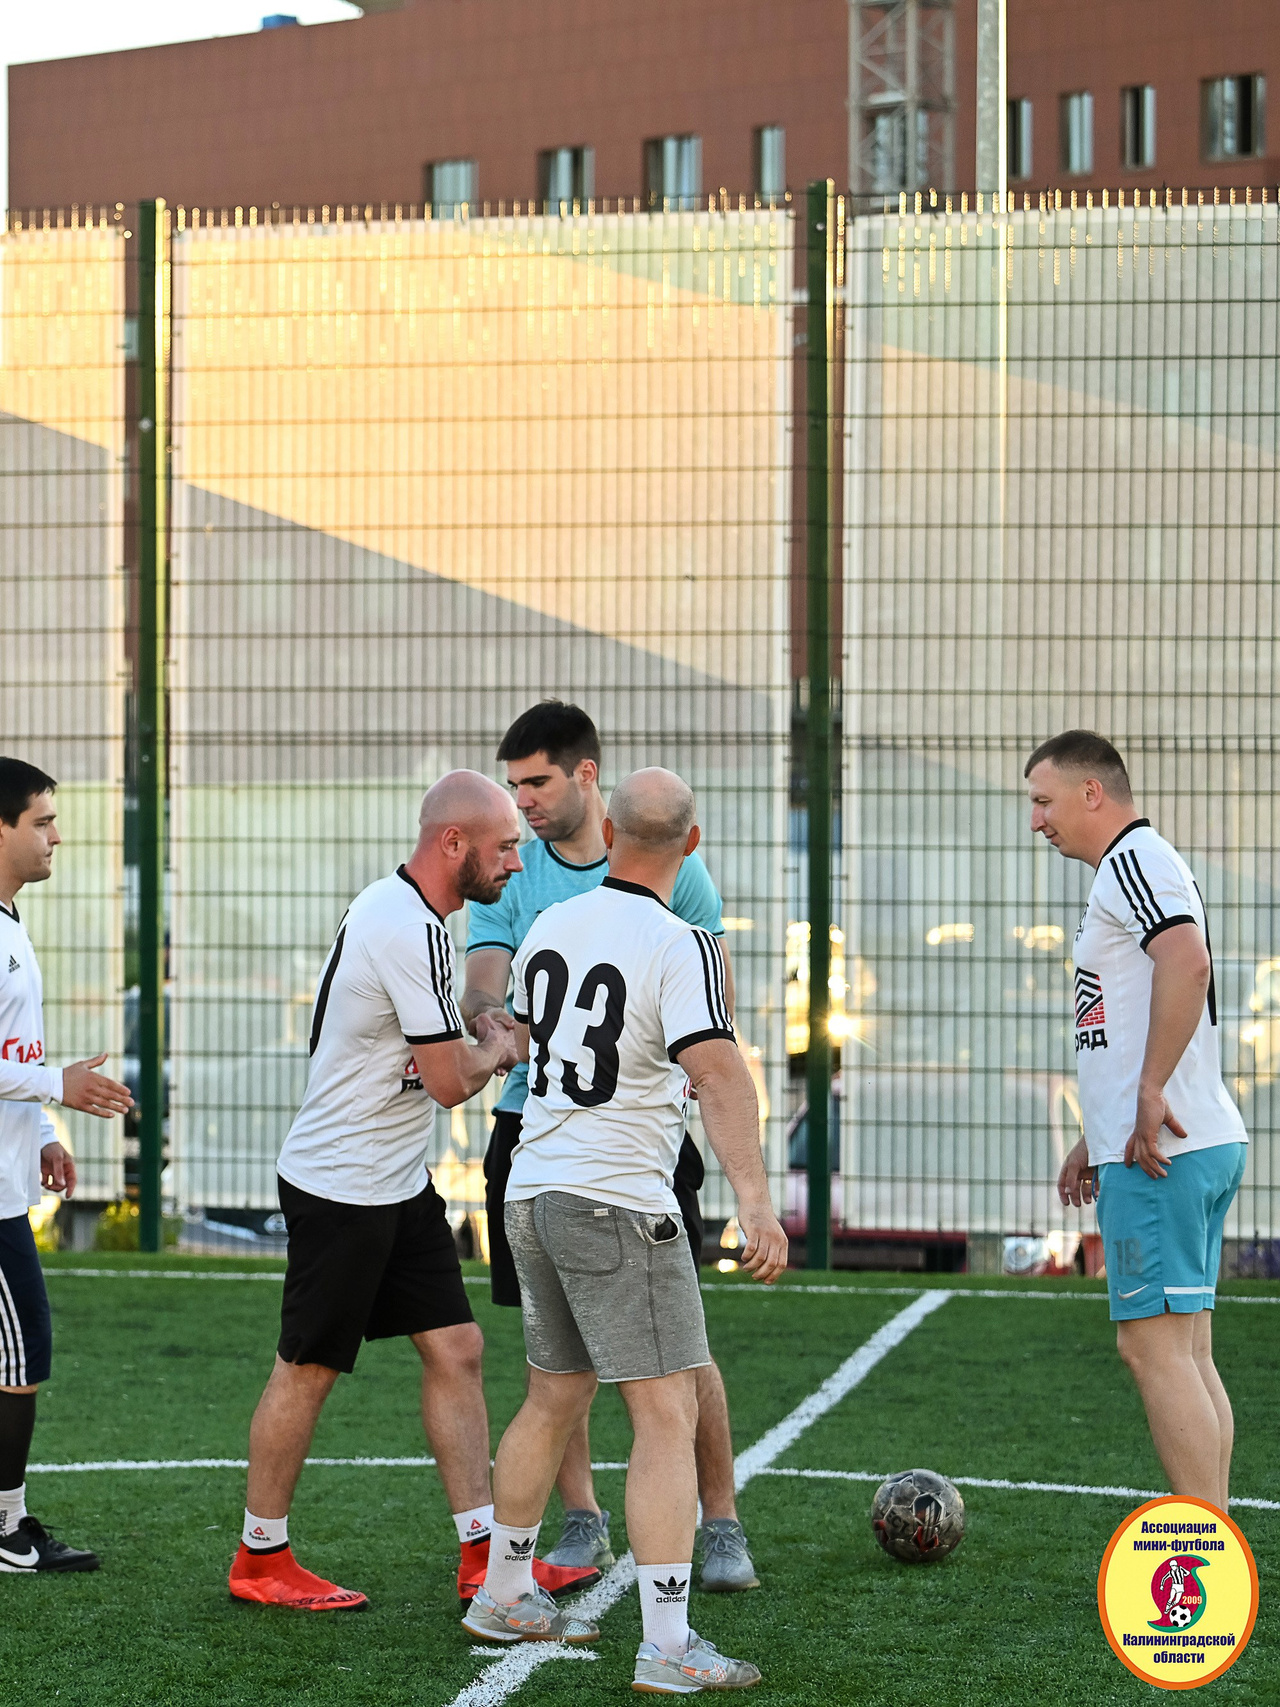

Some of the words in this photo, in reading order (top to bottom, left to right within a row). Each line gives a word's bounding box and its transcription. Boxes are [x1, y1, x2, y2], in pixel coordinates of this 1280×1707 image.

[525, 949, 627, 1108] 93
[504, 1553, 532, 1562] adidas
[655, 1595, 687, 1604] adidas
